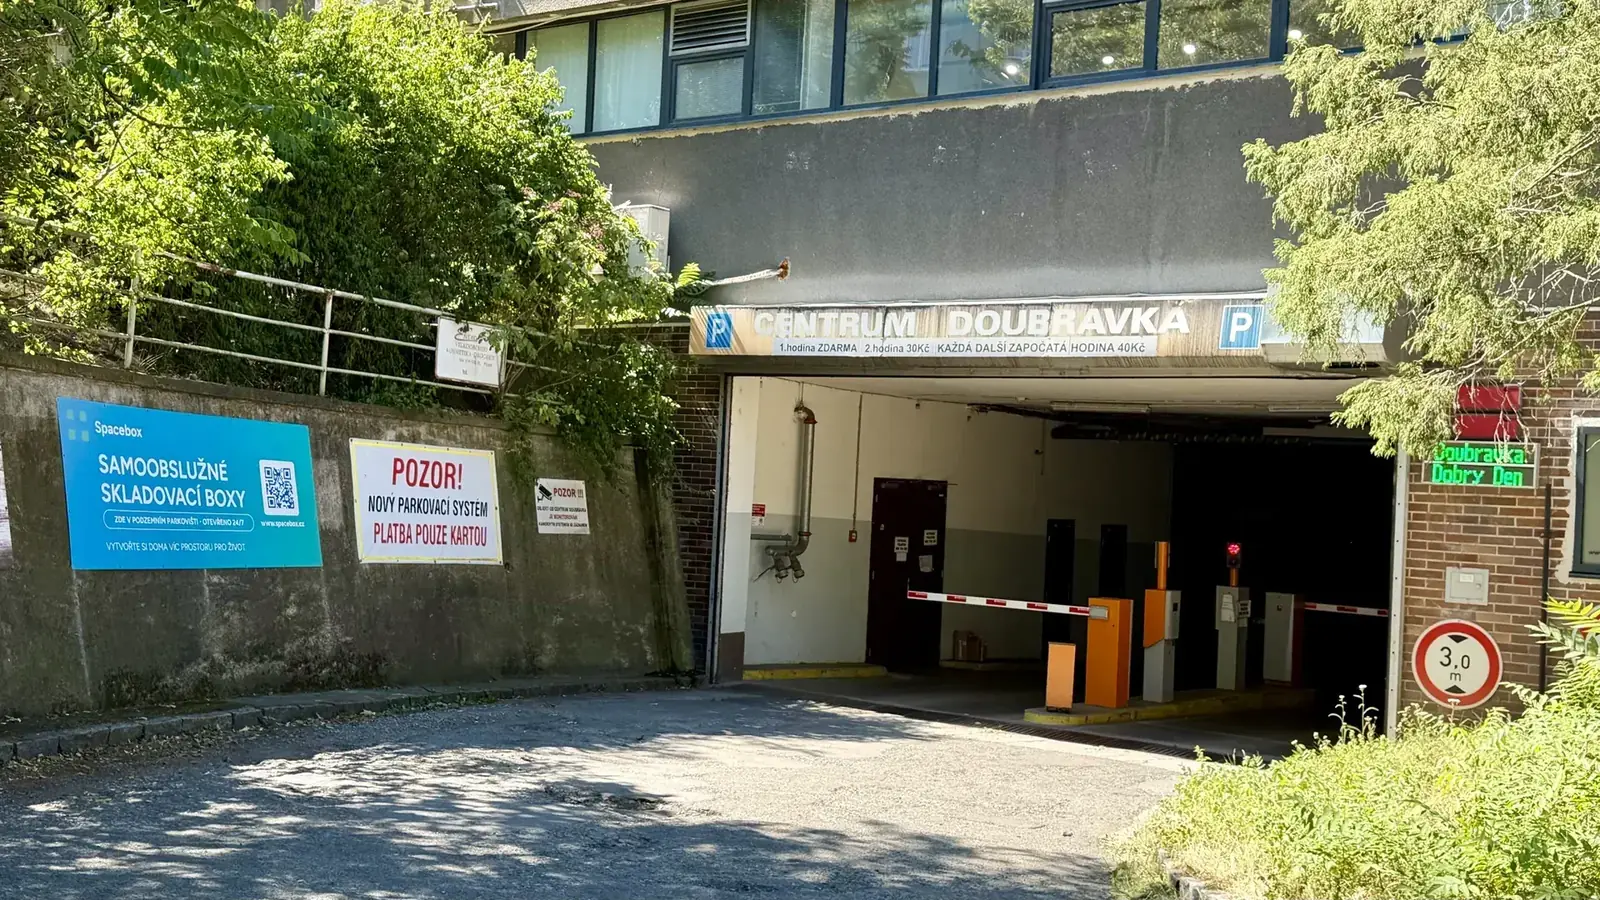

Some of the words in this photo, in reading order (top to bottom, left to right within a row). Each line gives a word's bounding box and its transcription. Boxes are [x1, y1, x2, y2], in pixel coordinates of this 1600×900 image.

[753, 311, 916, 338] CENTRUM
[780, 342, 816, 353] 1.hodina
[817, 342, 858, 353] ZDARMA
[865, 342, 904, 354] 2.hodina
[906, 342, 930, 353] 30Kč
[937, 340, 973, 353] KAŽDÁ
[975, 340, 1007, 353] DALŠÍ
[1008, 339, 1068, 353] ZAPOČATÁ
[1070, 342, 1115, 353] HODINA
[1117, 341, 1146, 353] 40Kč
[94, 419, 143, 438] Spacebox
[98, 453, 229, 482] SAMOOBSLUŽNÉ
[392, 457, 463, 490] POZOR!
[1432, 464, 1485, 485] Dobry
[1493, 466, 1523, 487] Den
[101, 483, 203, 507] SKLADOVACÍ
[205, 489, 246, 508] BOXY
[553, 487, 576, 498] POZOR
[368, 492, 395, 513] NOVÝ
[398, 495, 451, 516] PARKOVACÍ
[453, 497, 488, 518] SYSTÉM
[114, 515, 126, 524] ZDE
[126, 516, 132, 524] V
[132, 515, 166, 525] PODZEMNÍM
[167, 516, 199, 525] PARKOVIŠTI
[202, 517, 232, 526] OTEVŘENO
[232, 518, 245, 526] 24/7
[260, 519, 305, 528] www.spacebox.cz
[106, 540, 140, 551] VYTVOŘTE
[141, 542, 148, 551] SI
[149, 542, 169, 551] DOMA
[169, 540, 180, 551] VÍC
[180, 542, 213, 551] PROSTORU
[214, 542, 227, 551] PRO
[227, 541, 246, 551] ŽIVOT
[373, 522, 413, 544] PLATBA
[415, 524, 448, 545] POUZE
[450, 525, 487, 547] KARTOU
[1439, 646, 1471, 670] 3,0
[1449, 671, 1462, 682] m
